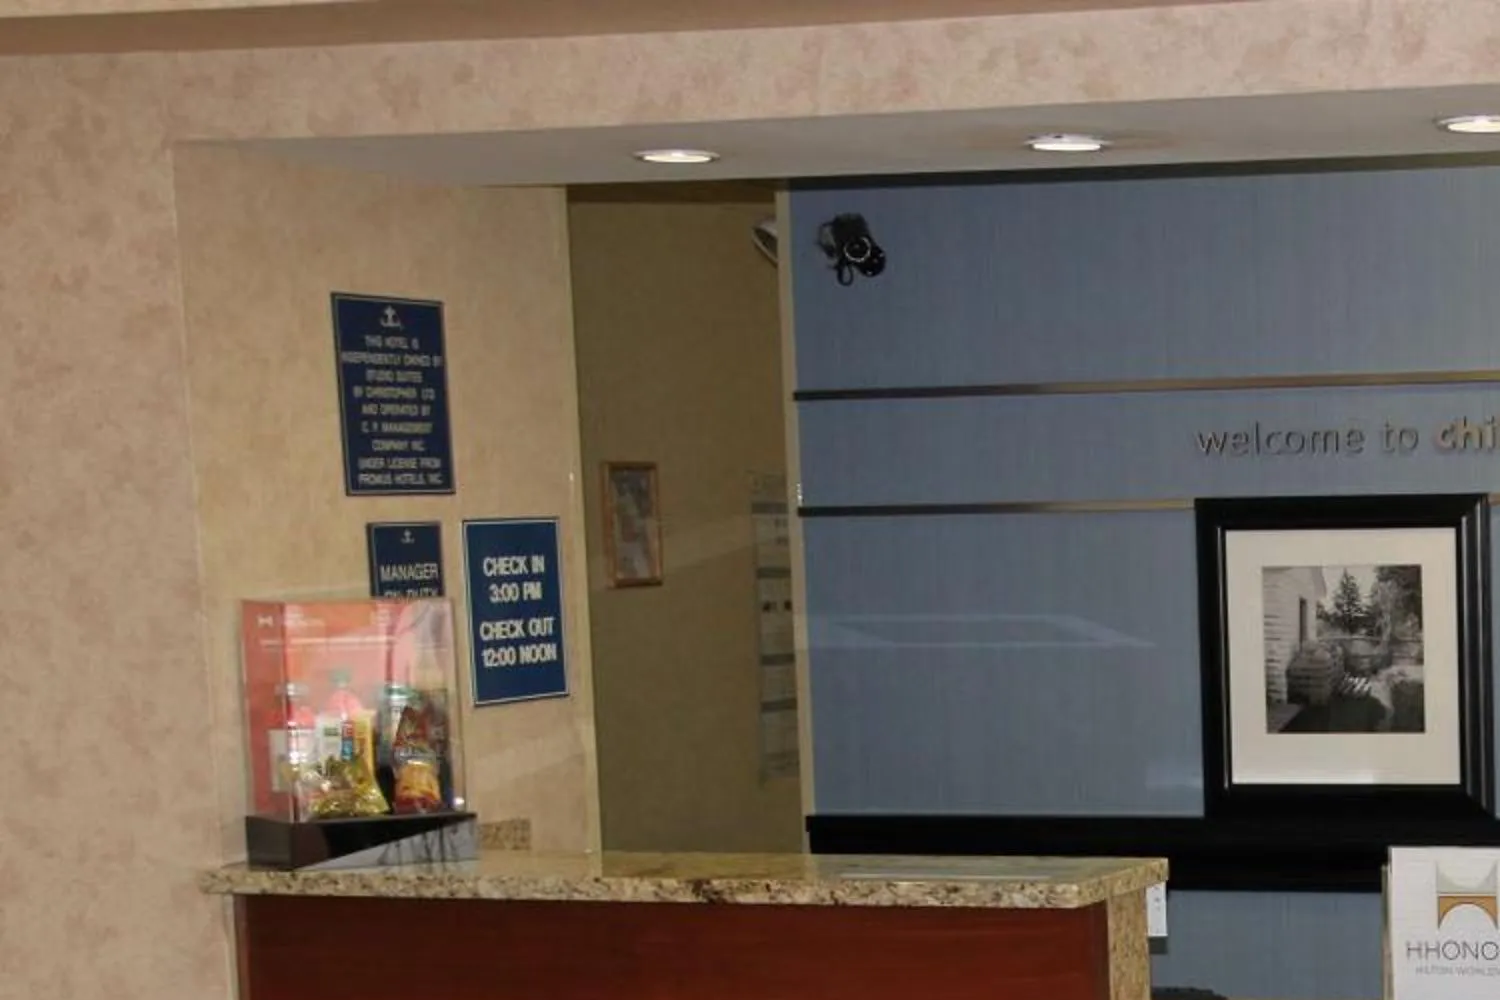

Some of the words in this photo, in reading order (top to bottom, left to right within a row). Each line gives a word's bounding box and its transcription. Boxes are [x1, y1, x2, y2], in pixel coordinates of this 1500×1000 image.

[1197, 420, 1367, 456] welcome
[1383, 419, 1420, 453] to
[380, 563, 439, 582] MANAGER
[483, 555, 529, 577] CHECK
[531, 553, 545, 574] IN
[489, 582, 520, 604] 3:00
[522, 580, 543, 601] PM
[480, 618, 526, 641] CHECK
[528, 616, 555, 637] OUT
[482, 645, 517, 667] 12:00
[519, 642, 557, 665] NOON
